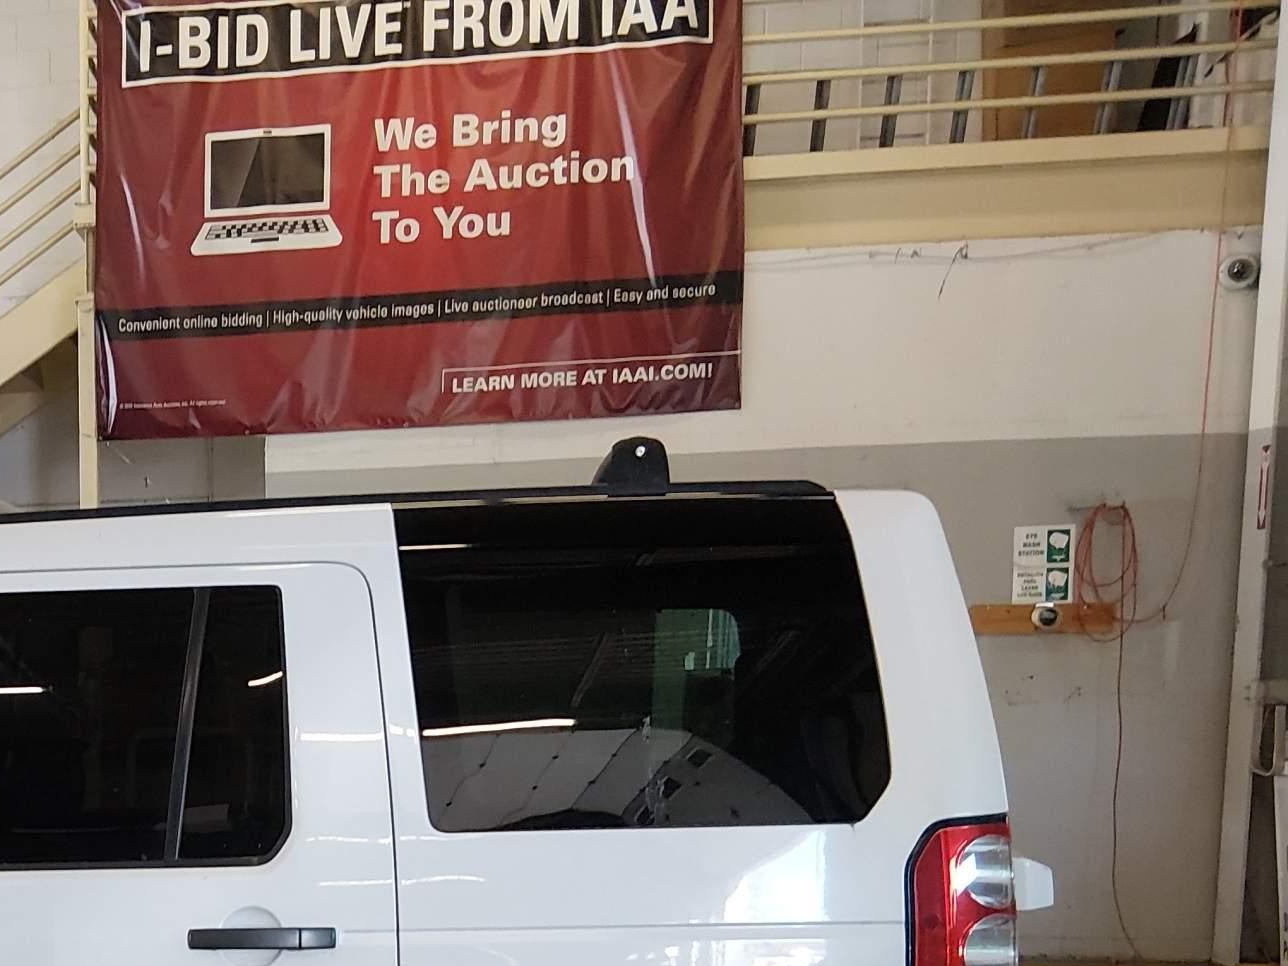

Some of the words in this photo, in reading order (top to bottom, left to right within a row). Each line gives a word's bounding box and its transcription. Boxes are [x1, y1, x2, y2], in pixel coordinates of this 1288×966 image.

[139, 14, 269, 72] I-BID
[423, 0, 579, 51] FROM
[601, 0, 698, 38] IAA
[375, 117, 437, 152] We
[453, 110, 567, 148] Bring
[373, 164, 450, 198] The
[464, 151, 634, 192] Auction
[372, 210, 420, 244] To
[433, 206, 511, 239] You
[118, 316, 181, 333] Convenient
[183, 315, 218, 330] online
[221, 312, 263, 330] bidding
[273, 307, 343, 326] High-quality
[345, 306, 388, 321] vehicle
[391, 303, 434, 319] images
[444, 299, 469, 314] Live
[472, 295, 538, 312] auctioneer
[541, 290, 604, 307] broadcast
[614, 288, 643, 304] Easy
[646, 286, 669, 300] and
[672, 284, 716, 299] secure
[452, 375, 514, 393] LEARN
[521, 369, 578, 389] MORE
[581, 369, 607, 386] AT
[613, 363, 713, 384] IAAI.COM!
